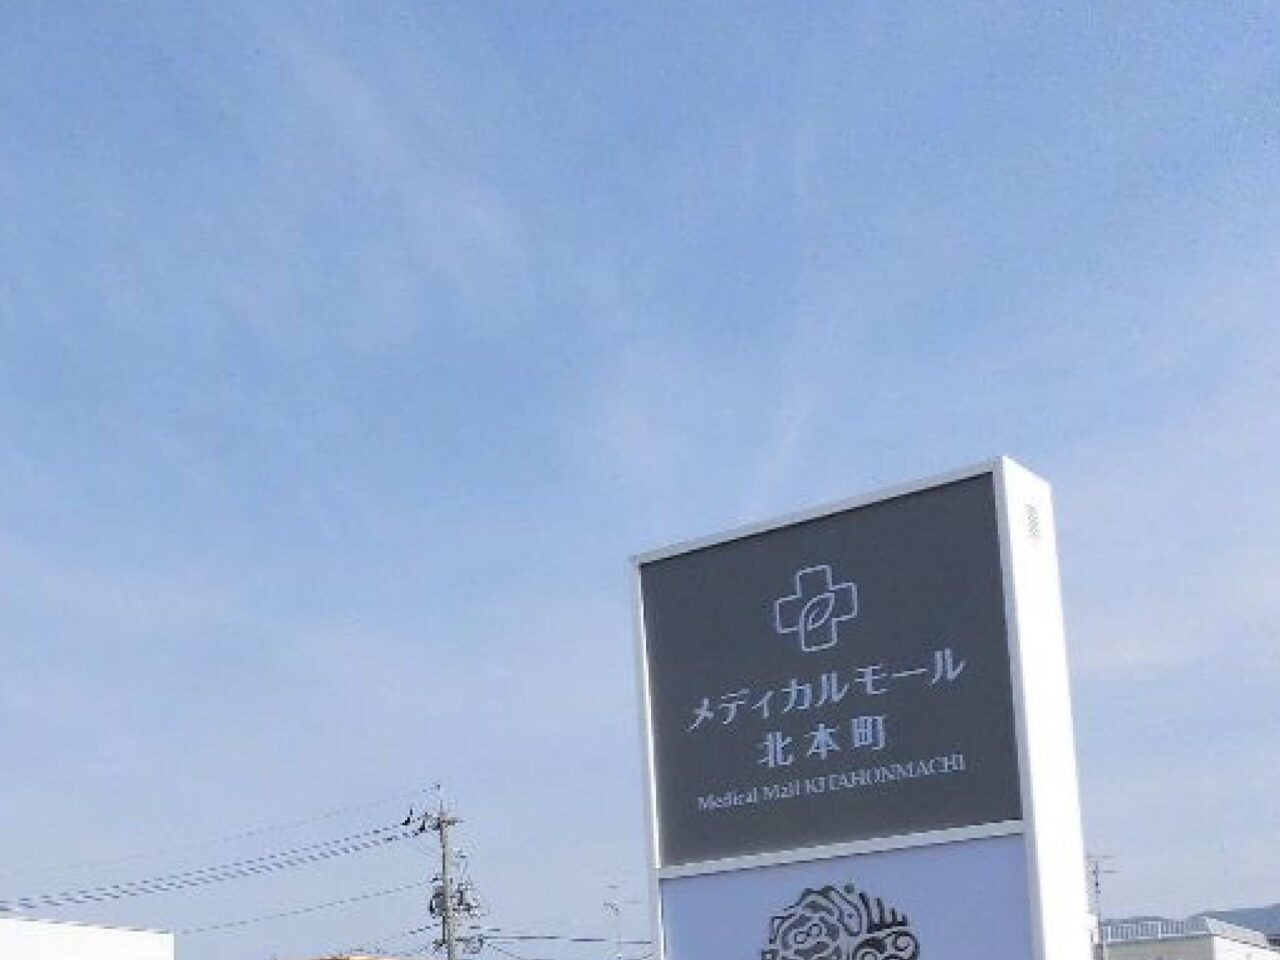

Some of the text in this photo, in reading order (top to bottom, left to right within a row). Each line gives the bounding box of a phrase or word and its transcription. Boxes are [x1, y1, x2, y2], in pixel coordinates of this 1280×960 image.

[686, 648, 965, 732] メディカルモール
[757, 715, 887, 769] 北本町
[698, 754, 965, 811] Medical Mall KITAHONMACHI
